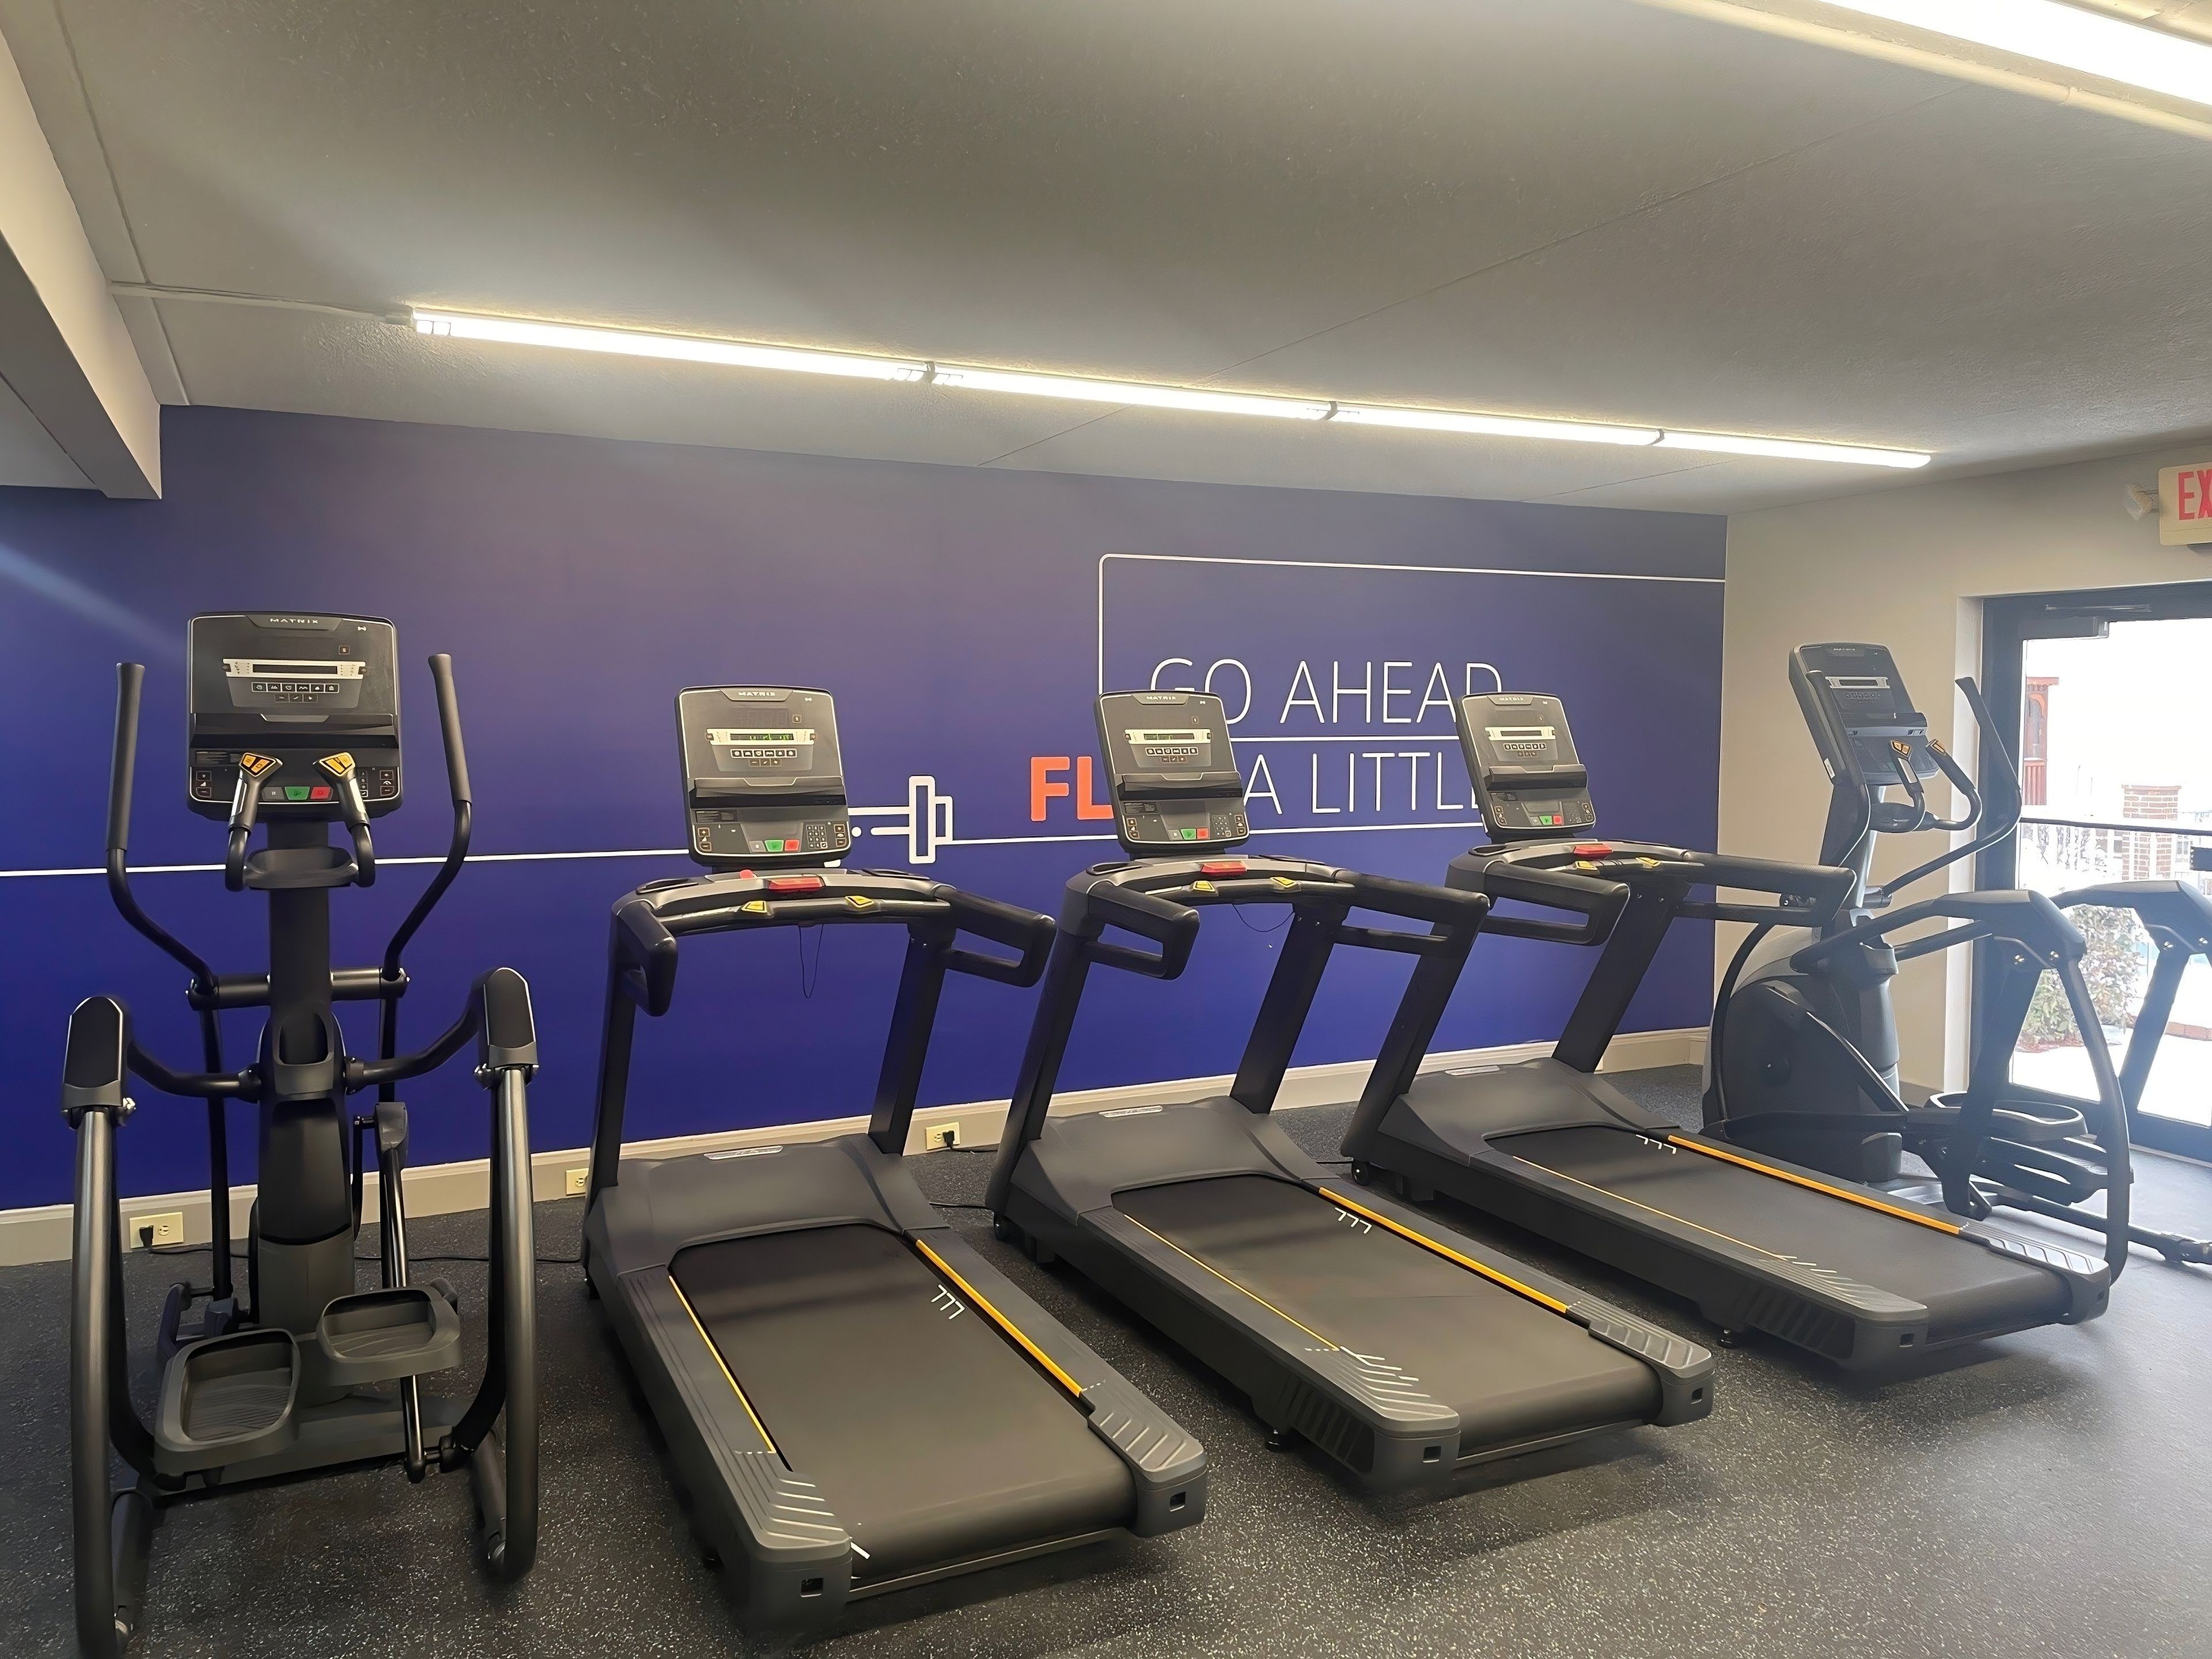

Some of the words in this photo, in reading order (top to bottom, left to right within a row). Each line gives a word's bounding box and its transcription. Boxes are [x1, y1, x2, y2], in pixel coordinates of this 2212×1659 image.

[2179, 469, 2212, 521] EX
[1280, 661, 1502, 724] AHEAD
[1030, 756, 1114, 822] FL
[1243, 754, 1282, 815] A
[1312, 752, 1478, 813] LITTL
